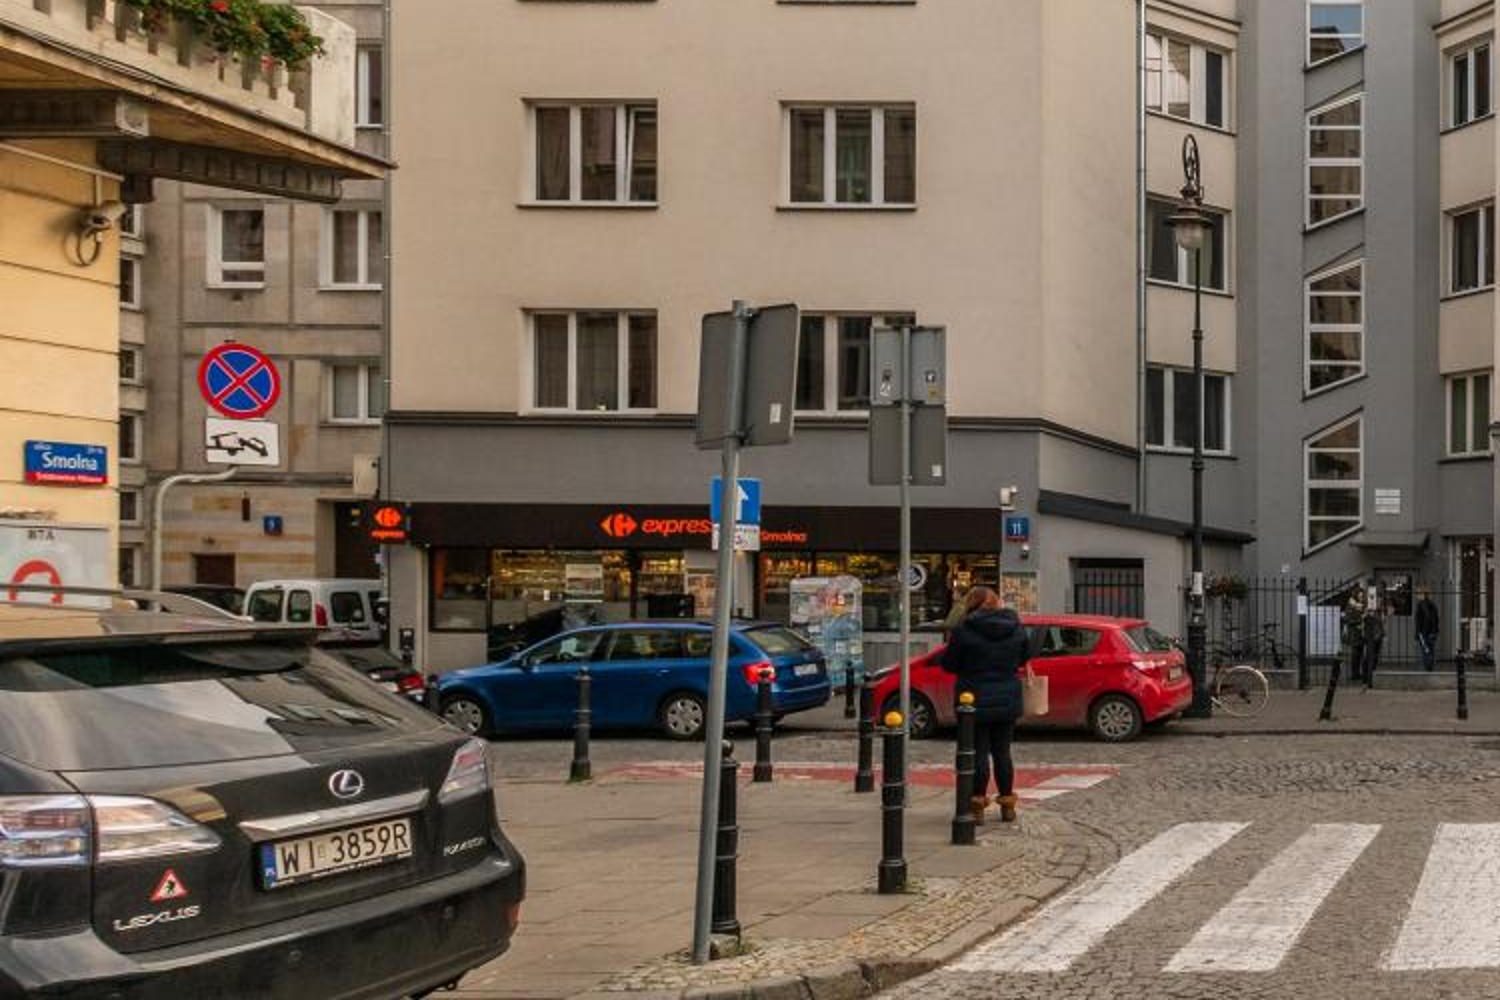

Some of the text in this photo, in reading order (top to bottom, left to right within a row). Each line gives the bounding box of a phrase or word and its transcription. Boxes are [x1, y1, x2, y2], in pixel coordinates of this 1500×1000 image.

[41, 452, 98, 471] Smolna
[641, 519, 713, 537] expres
[281, 840, 315, 875] WI
[330, 822, 408, 863] 3859R
[112, 905, 200, 931] LEXUS
